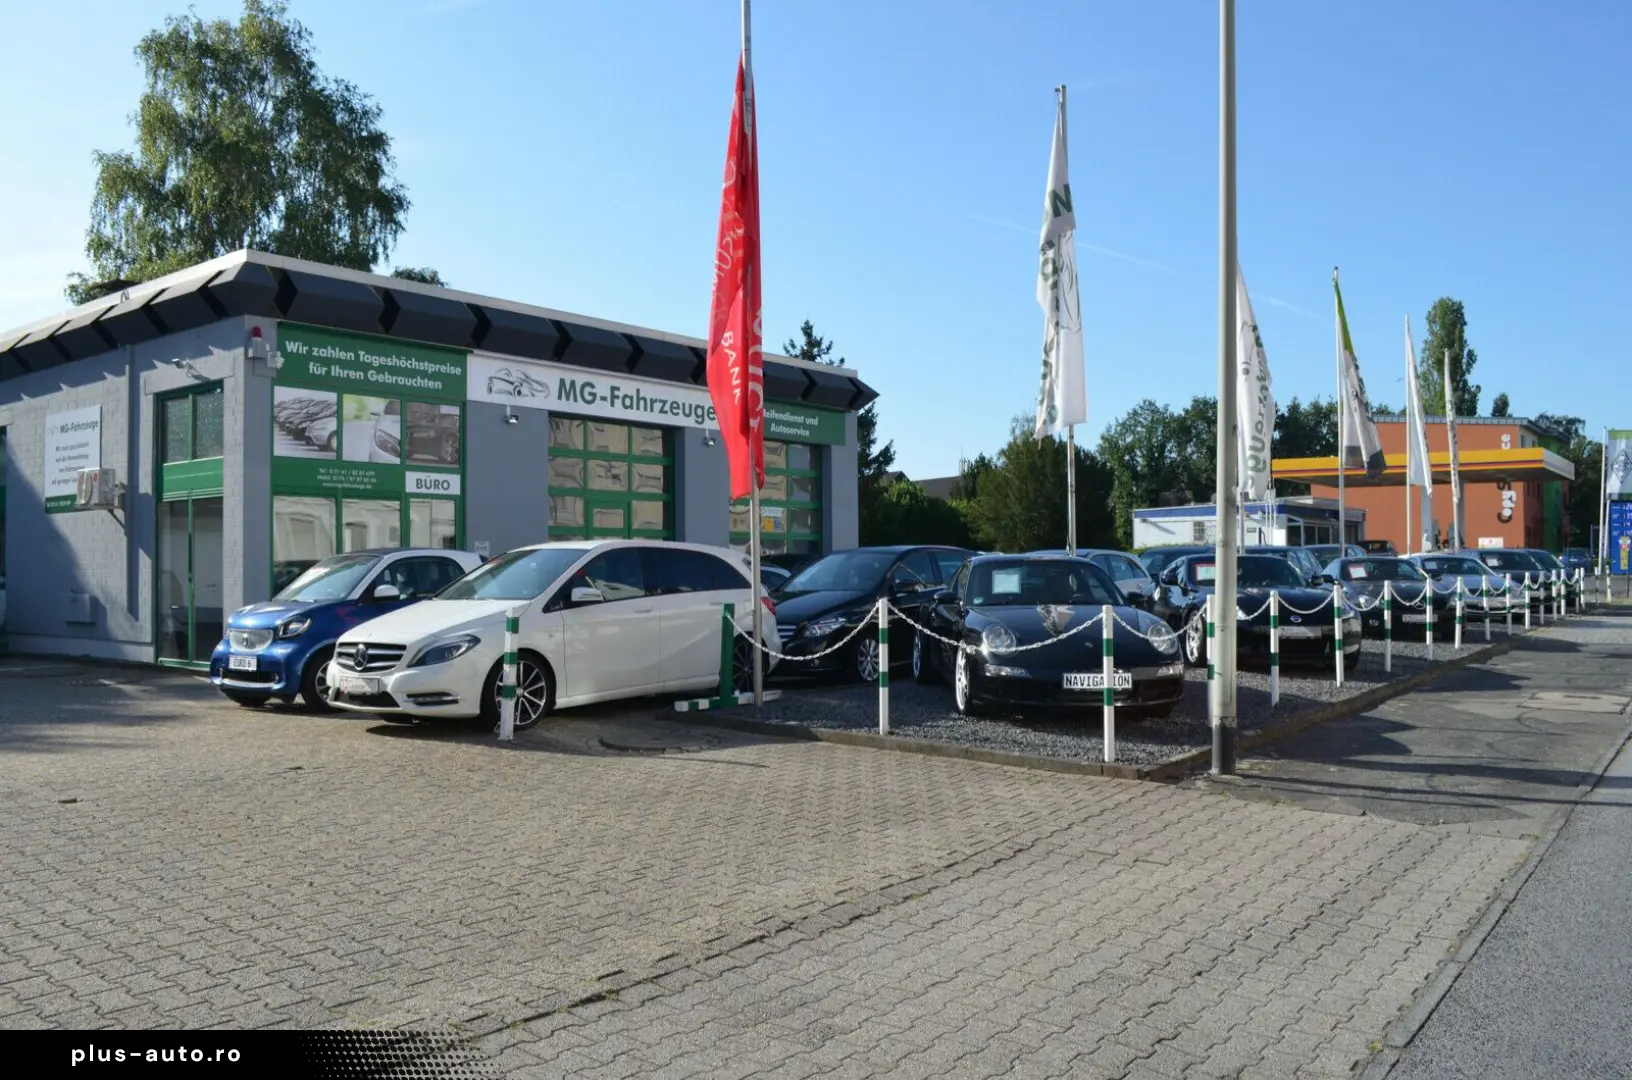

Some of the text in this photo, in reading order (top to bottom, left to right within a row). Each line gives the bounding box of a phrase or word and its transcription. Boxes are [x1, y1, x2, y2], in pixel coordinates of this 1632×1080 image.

[285, 341, 462, 376] Wir zahlen Tageshöchstpreise
[309, 362, 442, 389] für Ihren Gebrauchten
[557, 377, 717, 425] MG-Fahrzeuge
[805, 416, 819, 426] und
[771, 423, 810, 437] Autoservice
[415, 475, 451, 491] BÜRO
[1065, 675, 1130, 687] NAVIGAION
